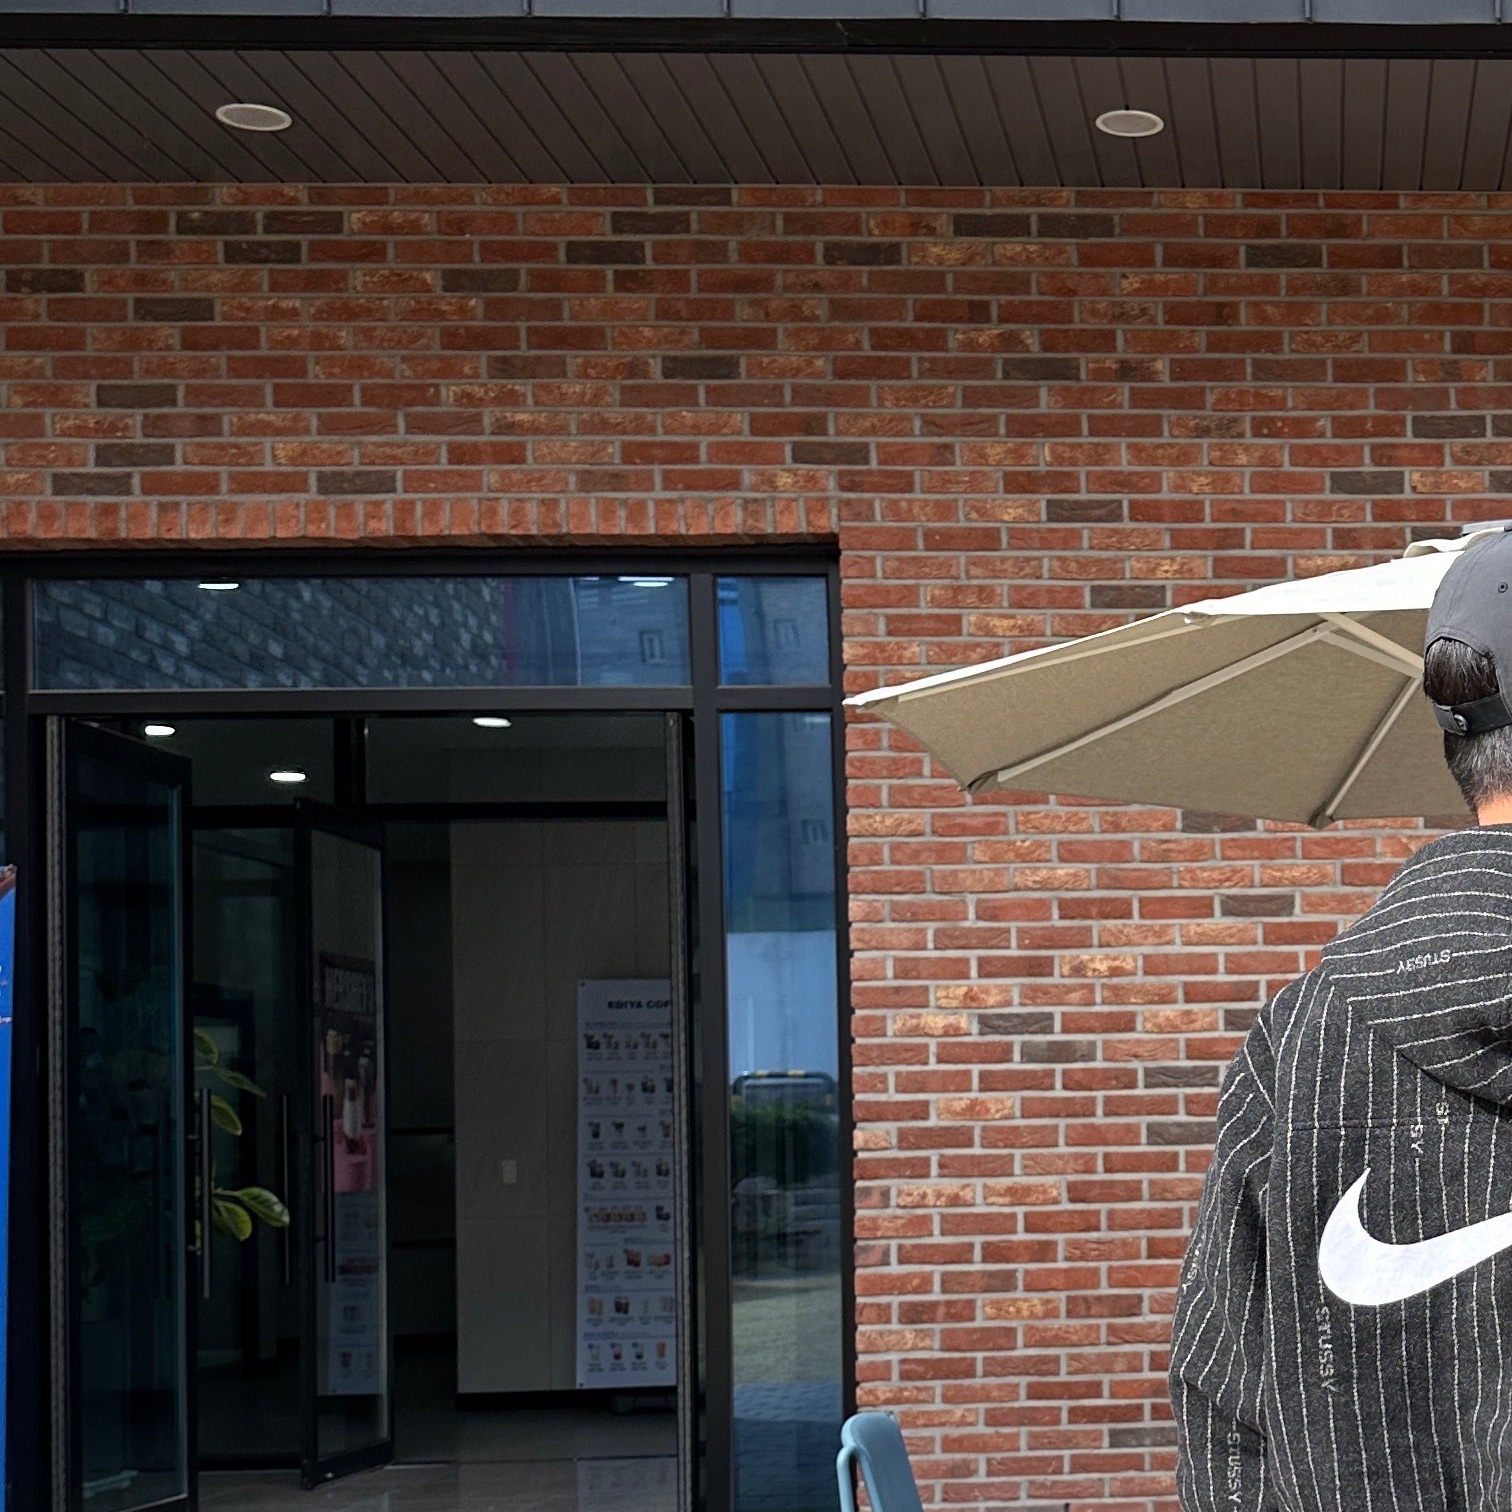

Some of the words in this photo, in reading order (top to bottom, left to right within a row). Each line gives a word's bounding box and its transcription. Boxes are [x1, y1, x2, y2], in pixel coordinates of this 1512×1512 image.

[1396, 949, 1451, 974] STUSSY
[608, 1000, 643, 1010] EDIYA
[1316, 1306, 1339, 1392] STUSSY
[1227, 1432, 1242, 1503] STUSSY
